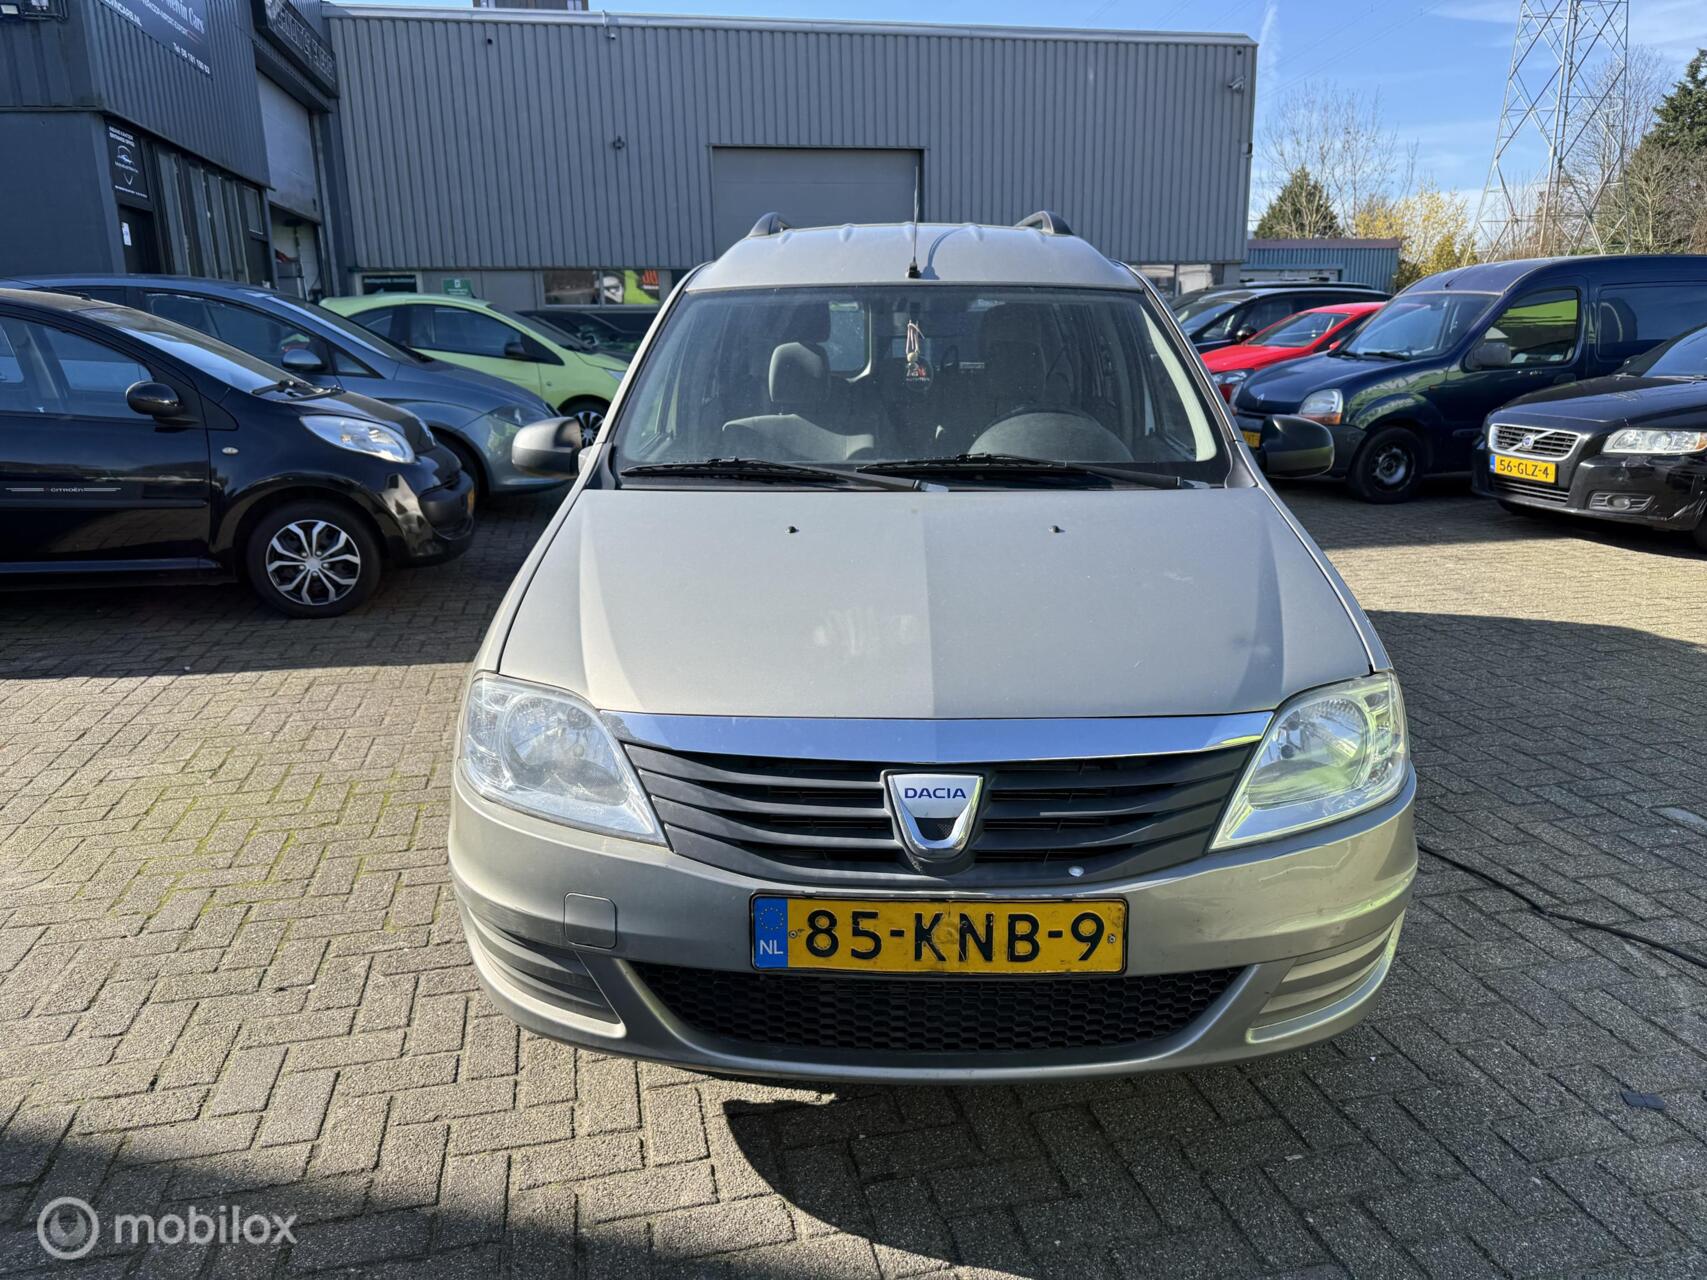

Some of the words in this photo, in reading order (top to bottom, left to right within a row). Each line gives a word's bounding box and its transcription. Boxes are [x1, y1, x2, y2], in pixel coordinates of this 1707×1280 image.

[1500, 459, 1550, 479] 56-GLZ-4
[904, 787, 967, 799] DACIA
[760, 939, 784, 955] NL
[805, 909, 1105, 962] 85-KNB-9
